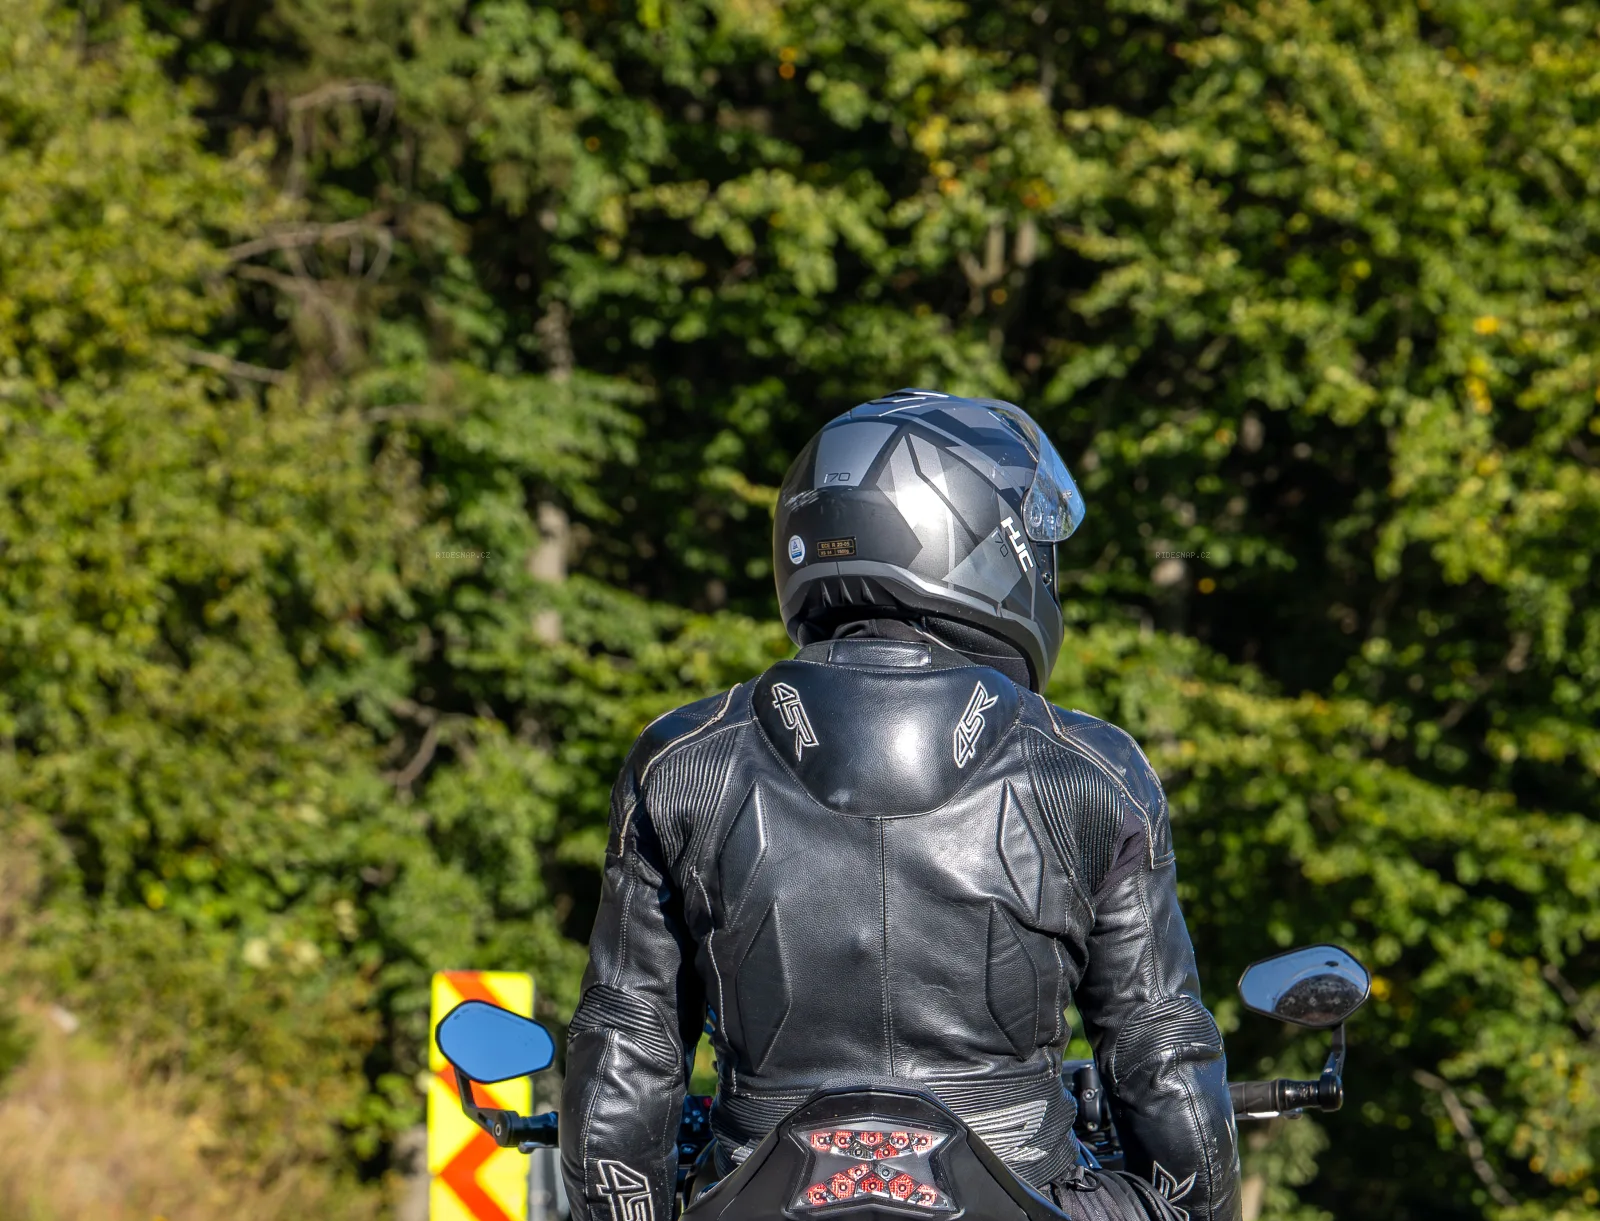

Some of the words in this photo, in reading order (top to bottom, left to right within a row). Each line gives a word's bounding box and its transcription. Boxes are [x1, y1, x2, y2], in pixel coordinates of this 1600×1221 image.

[823, 472, 851, 484] i70
[991, 530, 1009, 558] i70
[1000, 516, 1034, 572] HJC
